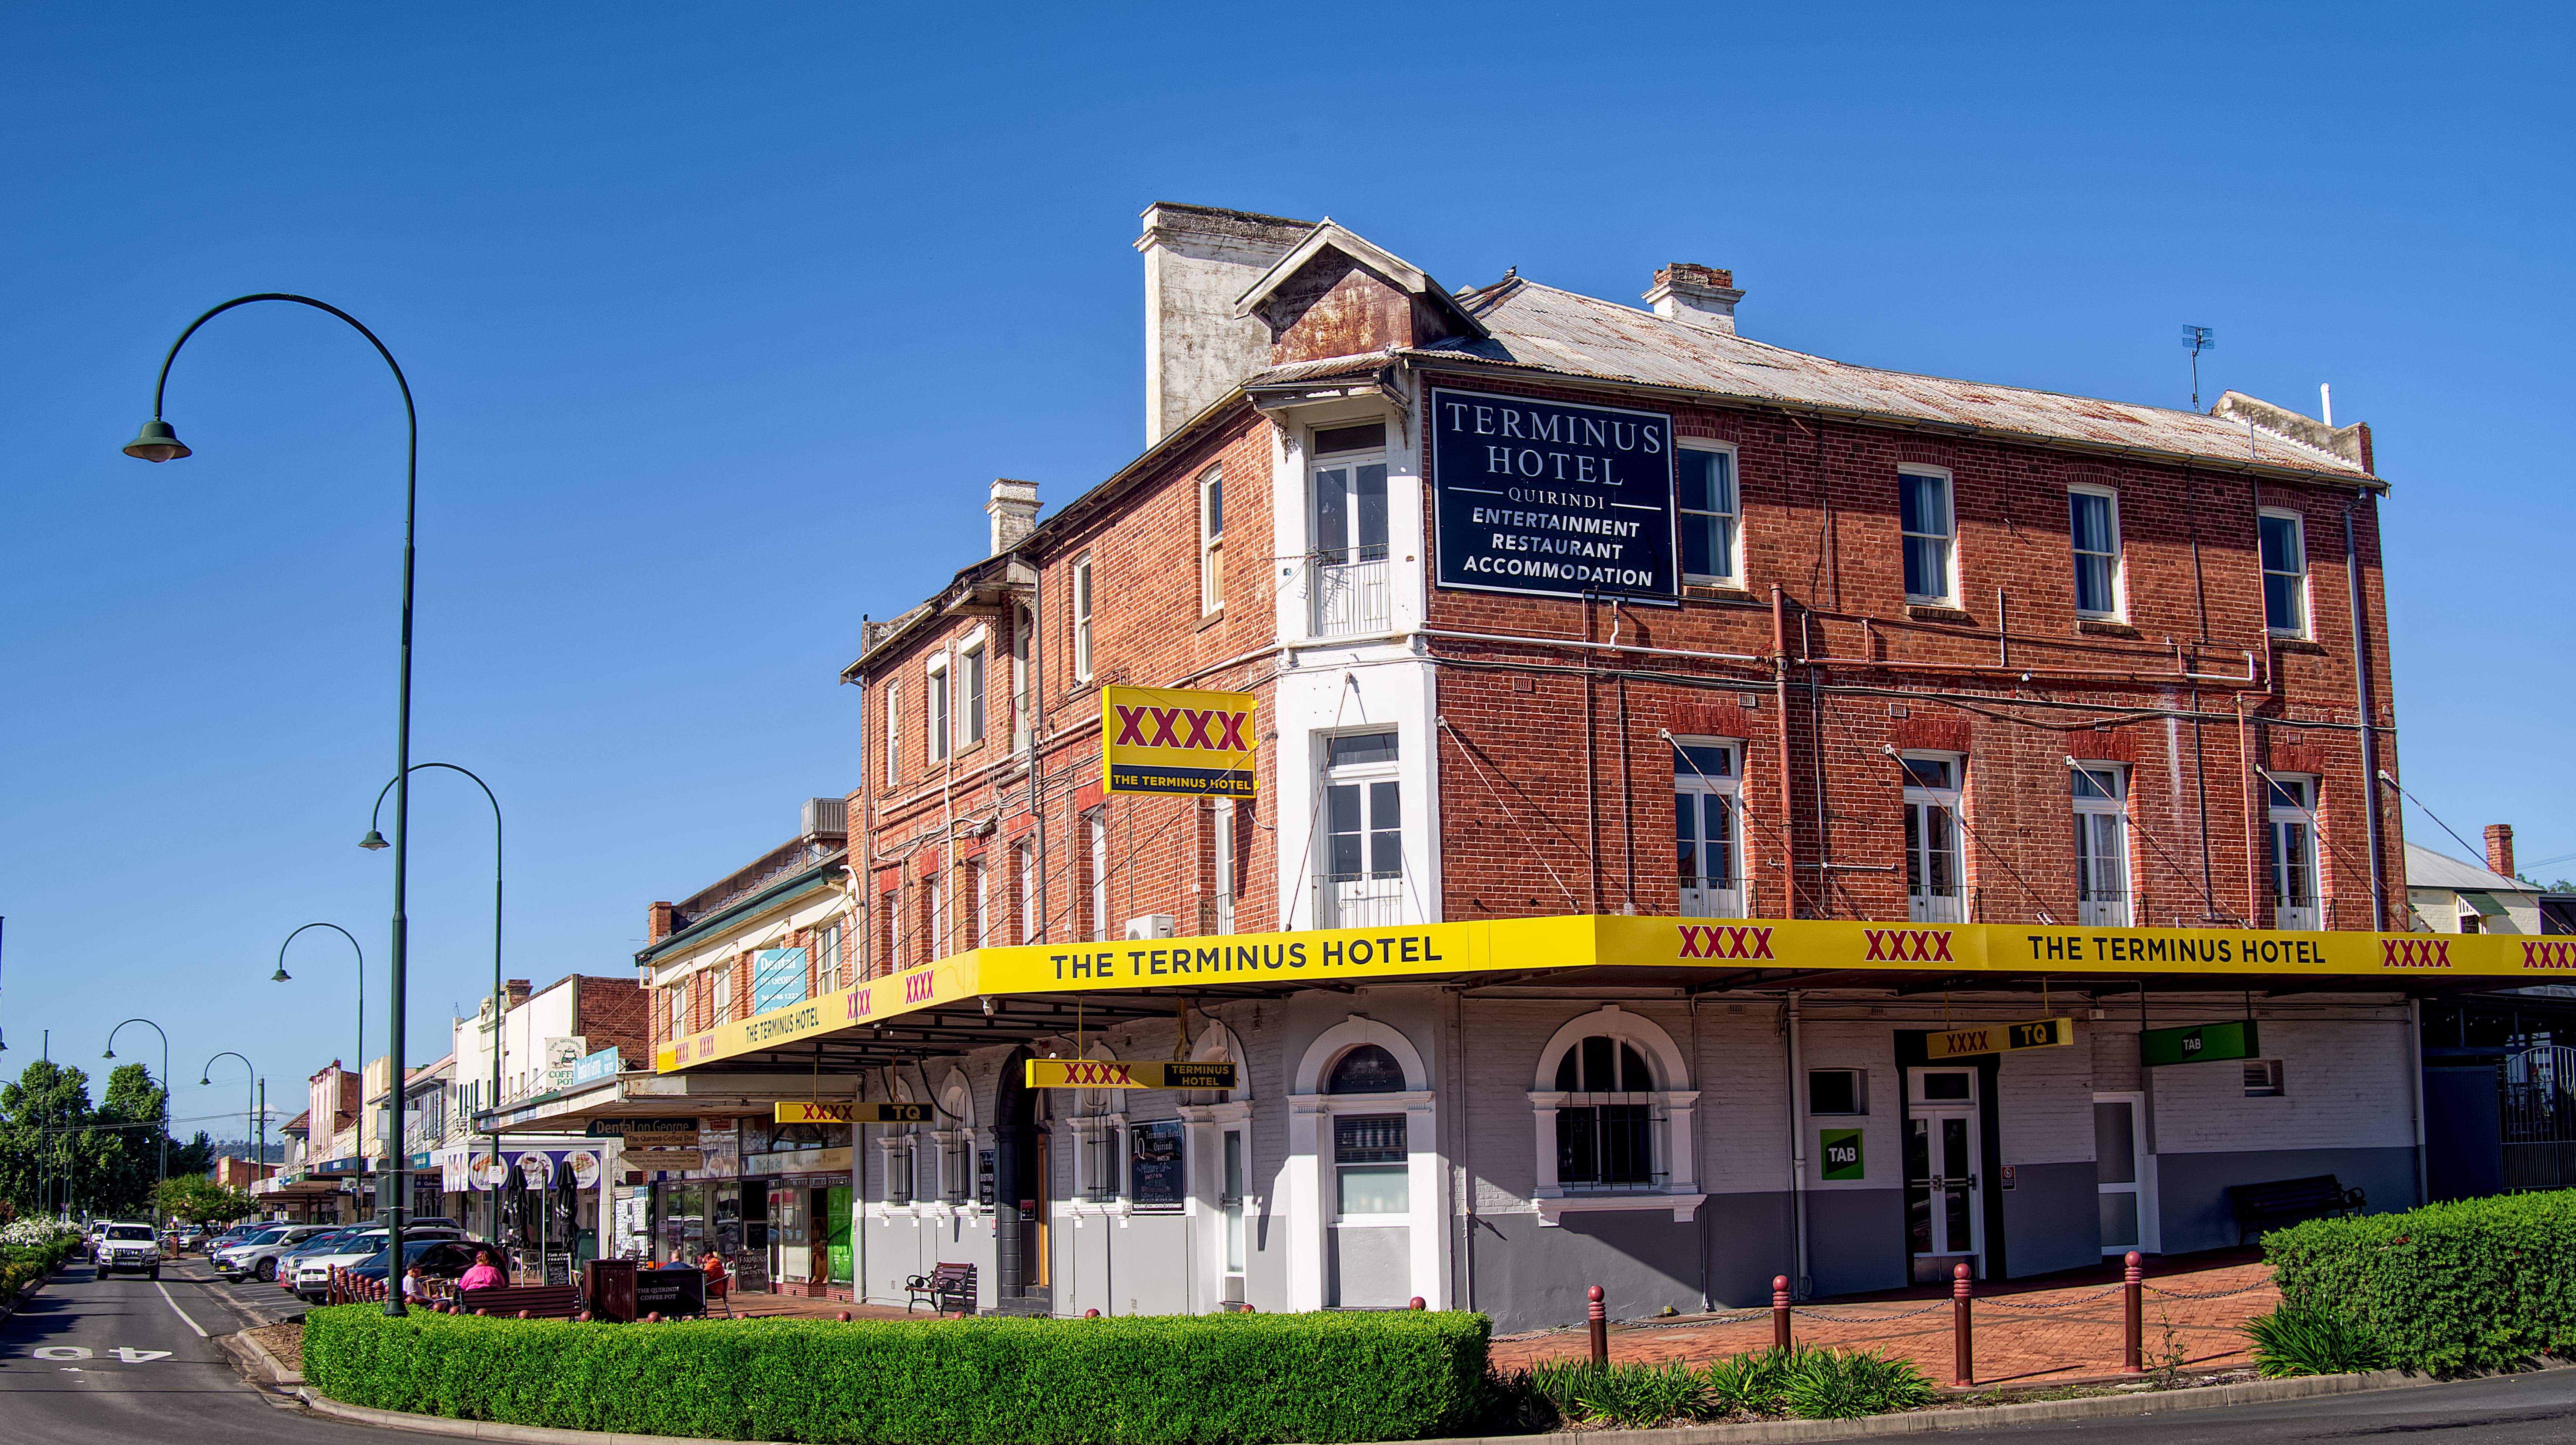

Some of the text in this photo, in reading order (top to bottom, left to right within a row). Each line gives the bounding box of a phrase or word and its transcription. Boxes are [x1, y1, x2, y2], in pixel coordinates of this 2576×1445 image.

[1446, 402, 1660, 453] TERMINUS
[1485, 445, 1624, 486] HOTEL
[1508, 487, 1605, 509] QUIRINDI
[1472, 507, 1640, 537] ENTERTAINMENT
[1492, 533, 1623, 560] RESTAURANT
[1463, 556, 1652, 587] ACCOMMODATION
[1114, 704, 1249, 752] XXXX
[1114, 775, 1251, 791] THE TERMINUS HOTEL
[1676, 924, 1776, 960] XXXX
[1863, 928, 1955, 962] XXXX
[2027, 935, 2325, 964] THE TERMINUS HOTEL
[2381, 938, 2453, 968] XXXX
[760, 955, 796, 971] Dental
[1050, 936, 1443, 979] THE TERMINUS HOTEL
[760, 975, 799, 986] on George
[905, 969, 934, 1005] XXXX
[846, 988, 871, 1021] XXXX
[746, 1006, 819, 1044] THE TERMINUS HOTEL
[549, 1038, 583, 1052] THE QUIRINDI
[699, 1034, 715, 1059] XXXX
[1946, 1023, 2047, 1055] XXXX TQ
[2183, 1037, 2202, 1051] TAB
[675, 1041, 689, 1065] XXXX
[1063, 1063, 1133, 1085] XXXX
[1171, 1065, 1230, 1076] TERMINUS
[1181, 1077, 1220, 1087] HOTEL
[802, 1104, 920, 1120] XXXX TQ
[596, 1120, 689, 1133] Dental on George
[1145, 1128, 1181, 1139] Terminus Hotel
[1132, 1129, 1146, 1160] TQ
[1154, 1141, 1173, 1151] Quirindi
[1828, 1147, 1856, 1162] TAB
[980, 1173, 993, 1181] BISTRO
[739, 1255, 766, 1263] FARMHOUSE
